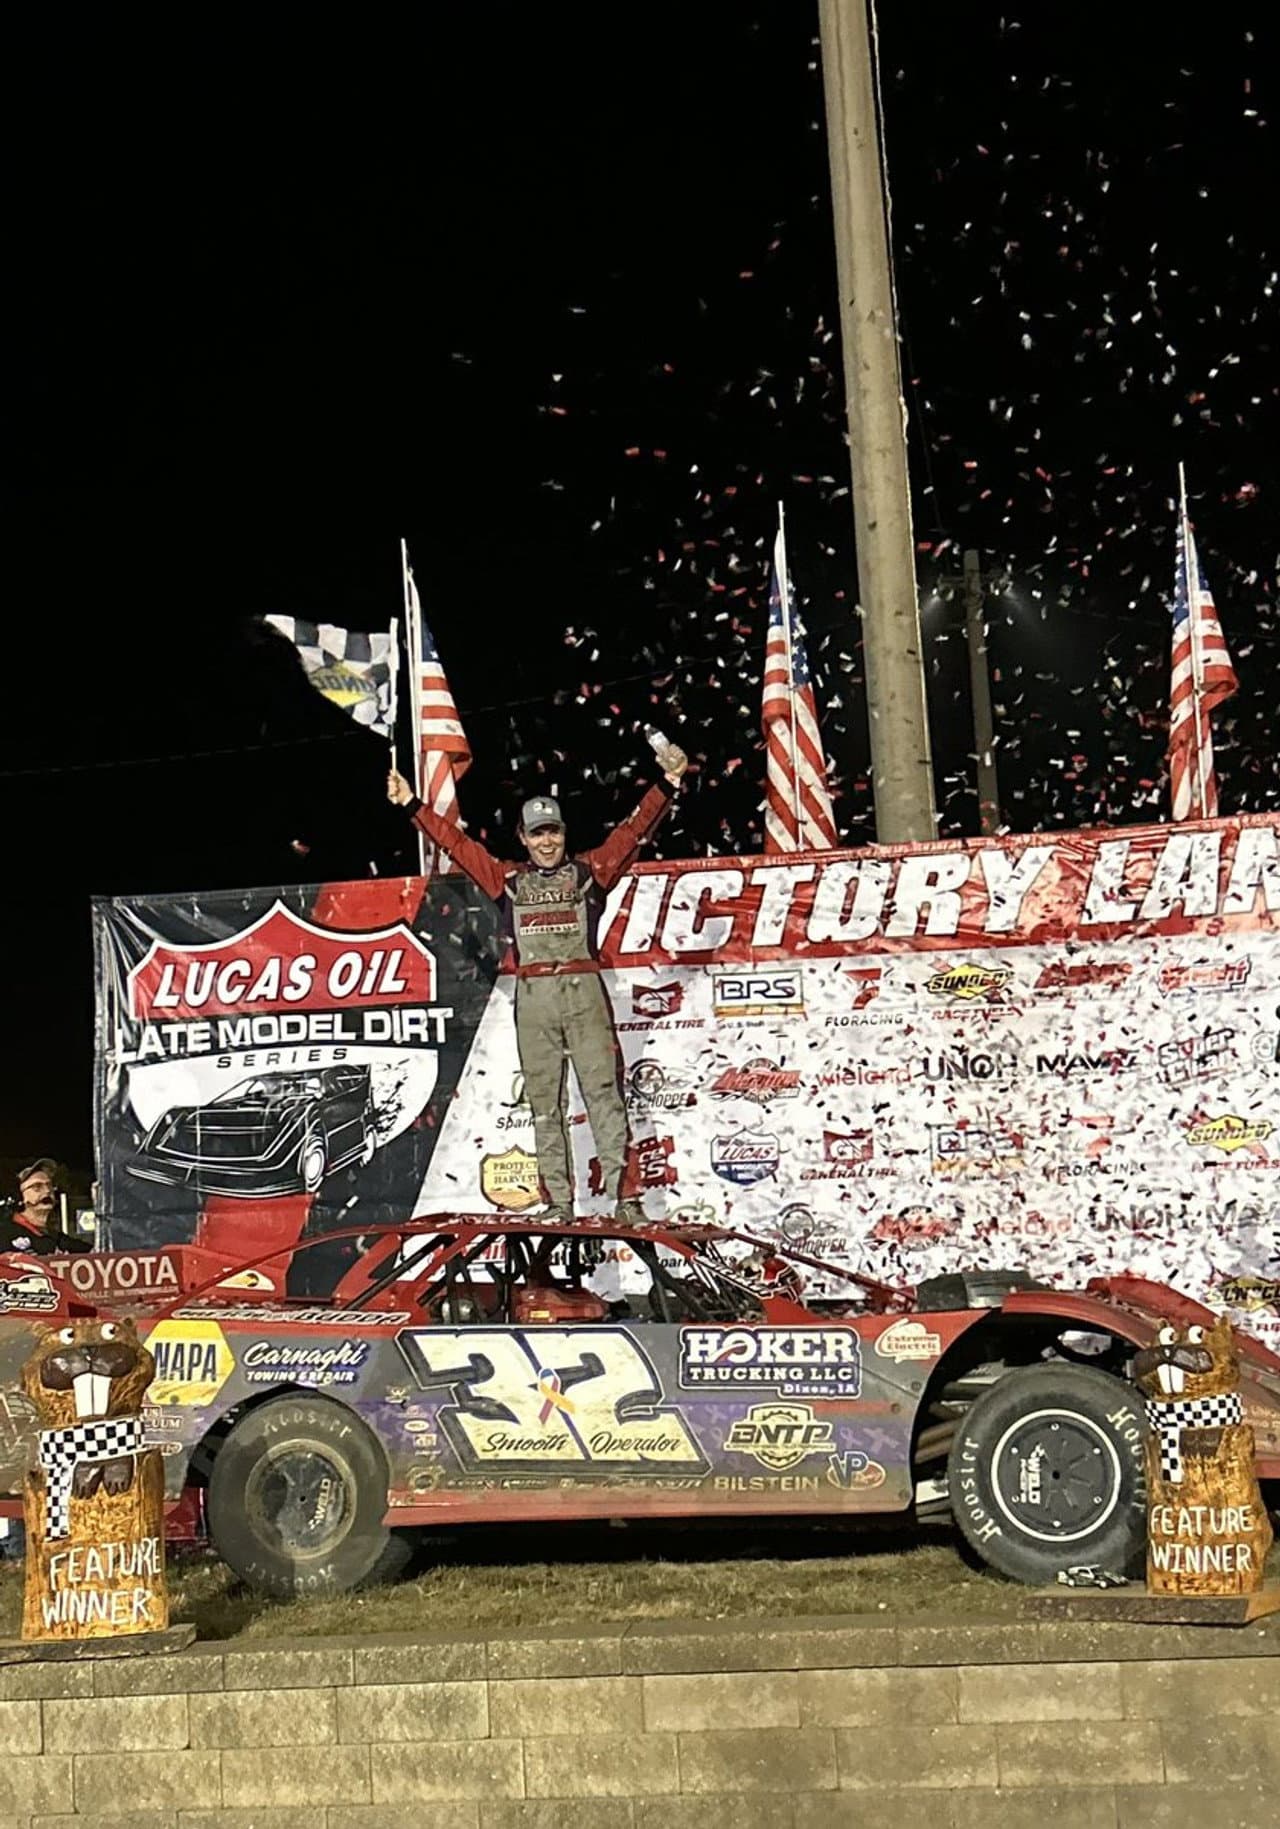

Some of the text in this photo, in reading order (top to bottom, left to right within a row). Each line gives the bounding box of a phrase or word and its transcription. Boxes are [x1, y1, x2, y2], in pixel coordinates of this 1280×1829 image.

[152, 949, 408, 1008] LUCAS OIL
[720, 978, 797, 1001] BRS
[115, 1008, 454, 1063] LATE MODEL DIRT
[615, 1020, 671, 1032] ENERAL
[675, 1019, 705, 1029] TIRE
[825, 1013, 904, 1027] FLORACING
[216, 1047, 349, 1069] SERIES
[719, 1147, 775, 1160] LUCAS
[50, 1255, 179, 1292] TOYOTA
[154, 1342, 217, 1382] NAPA
[243, 1339, 368, 1373] Carnaghi
[686, 1332, 855, 1363] HOKER
[247, 1370, 295, 1381] TOWING
[689, 1366, 853, 1380] TRUCKING LLC
[408, 1331, 704, 1464] 32
[481, 1431, 682, 1456] Smooth Operator
[714, 1476, 820, 1491] BILSTEIN
[829, 1454, 868, 1489] VP
[956, 1437, 1002, 1543] Hoosier
[1151, 1504, 1256, 1538] FEATURE
[50, 1537, 161, 1591] FEATURE
[1150, 1540, 1253, 1575] WINNER
[42, 1587, 155, 1629] WINNER
